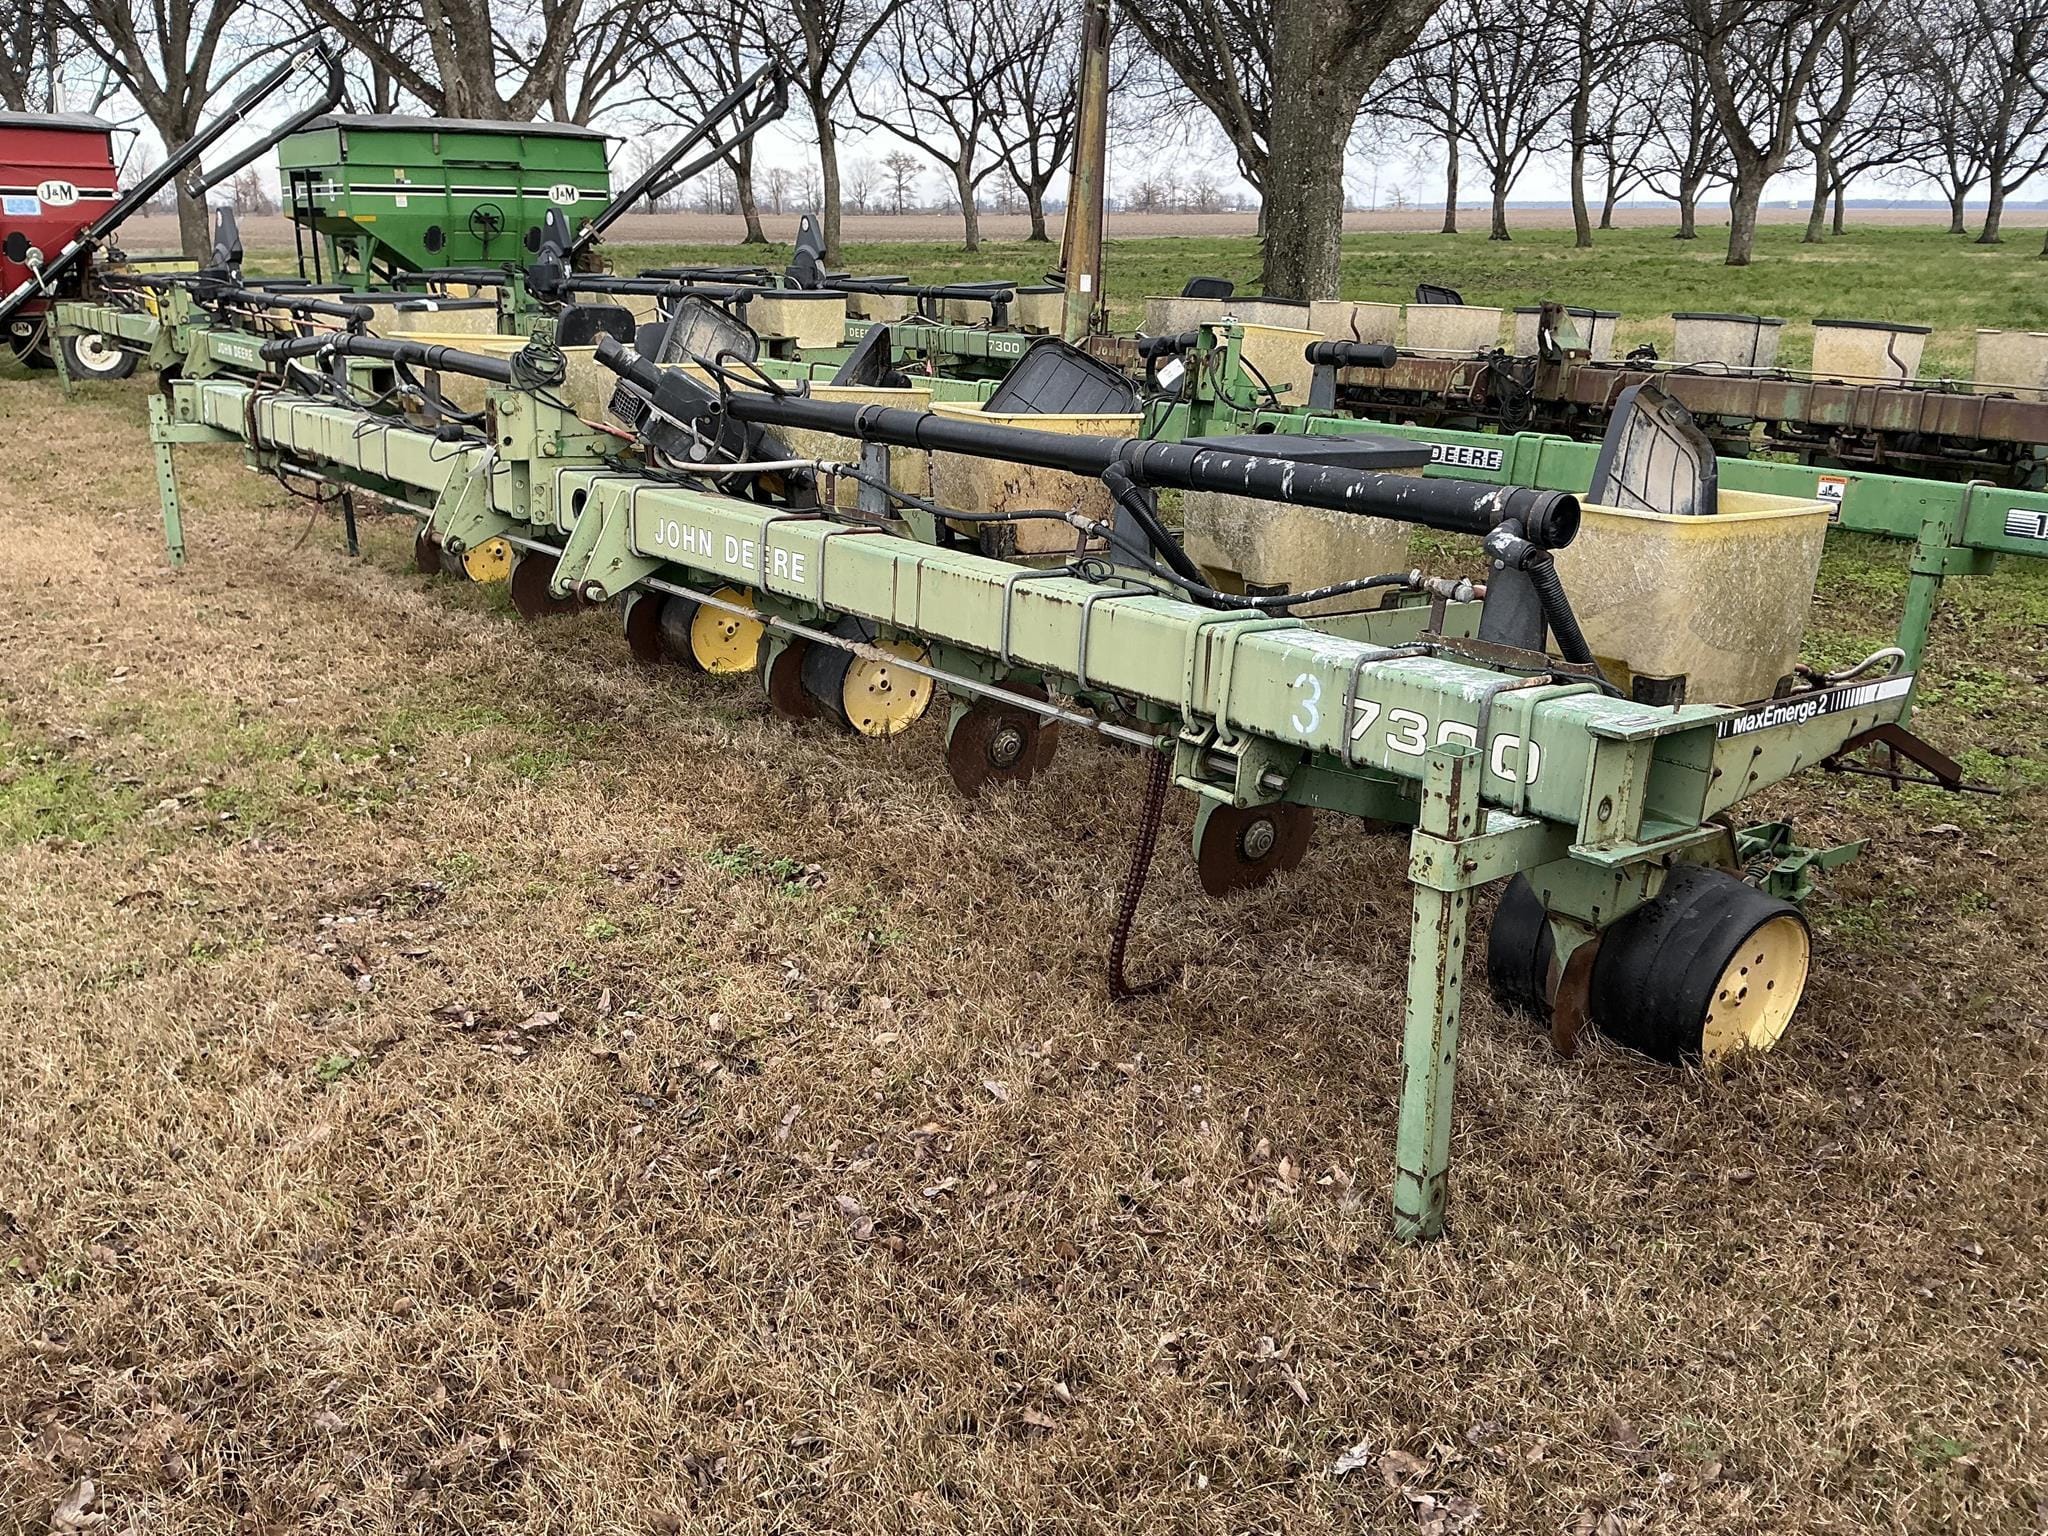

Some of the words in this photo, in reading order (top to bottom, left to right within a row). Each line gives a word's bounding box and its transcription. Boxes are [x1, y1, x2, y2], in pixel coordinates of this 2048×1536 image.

[41, 184, 73, 201] J&M
[552, 187, 575, 201] J&M
[988, 340, 1020, 353] 7300
[1431, 445, 1499, 467] DEERE
[655, 518, 712, 558] JOHN
[725, 535, 805, 584] DEERE
[1291, 673, 1322, 734] 3
[1733, 700, 1817, 734] MaxEmerge
[1817, 694, 1828, 715] 2
